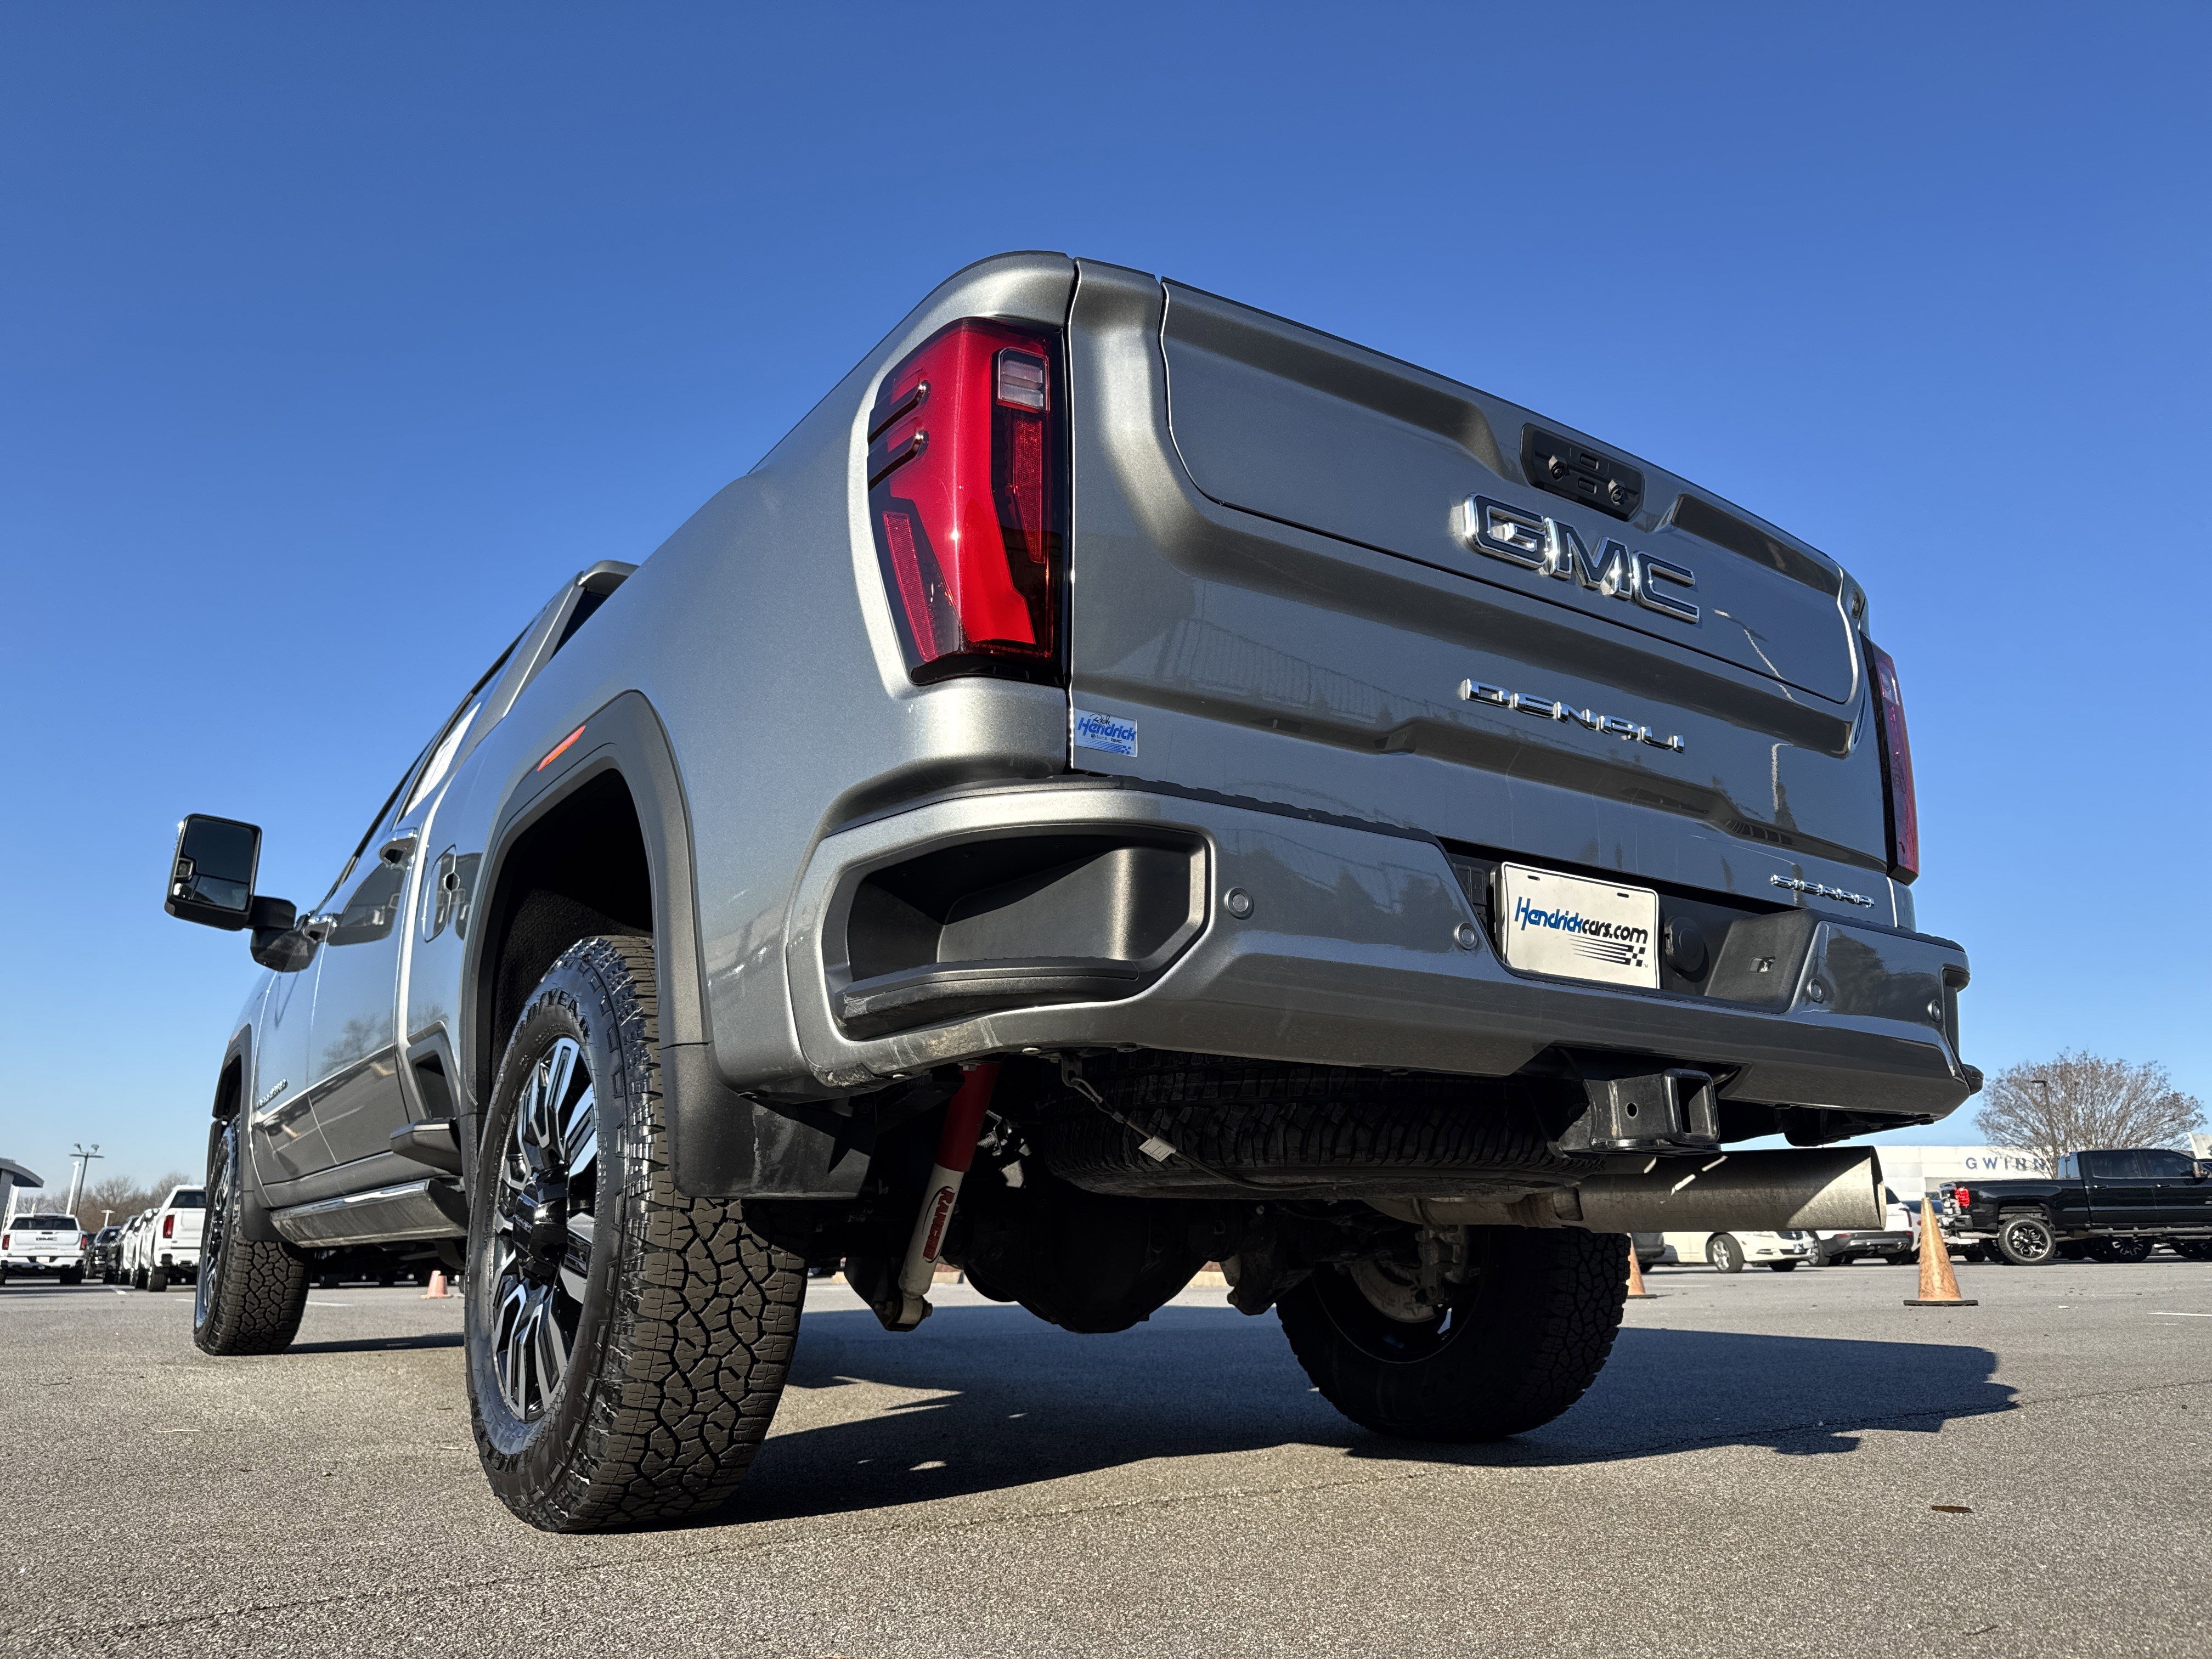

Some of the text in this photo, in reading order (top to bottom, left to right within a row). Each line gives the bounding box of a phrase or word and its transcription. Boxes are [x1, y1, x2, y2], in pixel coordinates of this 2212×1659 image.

[1463, 493, 1700, 624] GMC
[1077, 717, 1137, 741] Hendrick
[1461, 679, 1684, 753] DENALI
[1771, 874, 1875, 908] SIERRA
[1514, 896, 1649, 944] Hendrickcars.com
